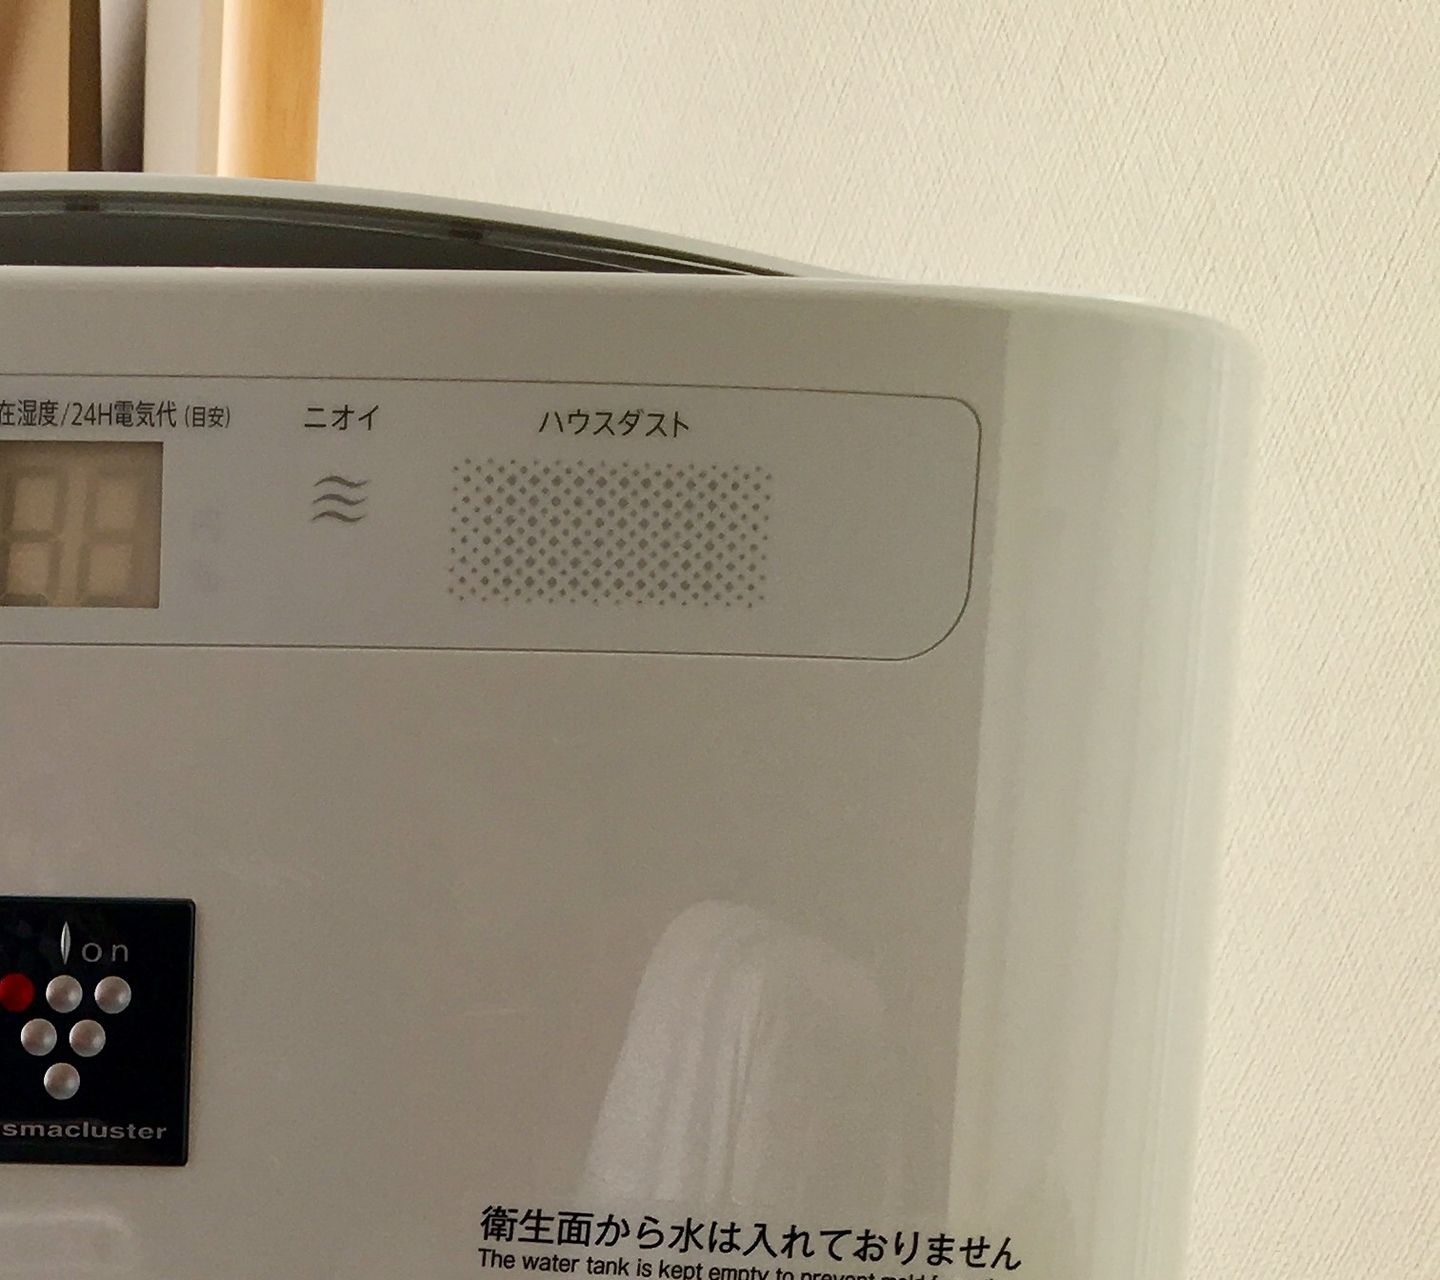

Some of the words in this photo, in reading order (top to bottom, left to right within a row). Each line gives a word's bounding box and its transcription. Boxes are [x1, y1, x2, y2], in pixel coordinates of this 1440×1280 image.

[304, 404, 380, 431] ニオイ
[538, 408, 690, 439] ハウスダスト
[480, 1205, 1022, 1271] 衛生面から水は入れておりません
[478, 1247, 516, 1269] The
[522, 1255, 580, 1273] water
[586, 1256, 630, 1277] tank
[636, 1258, 653, 1278] is
